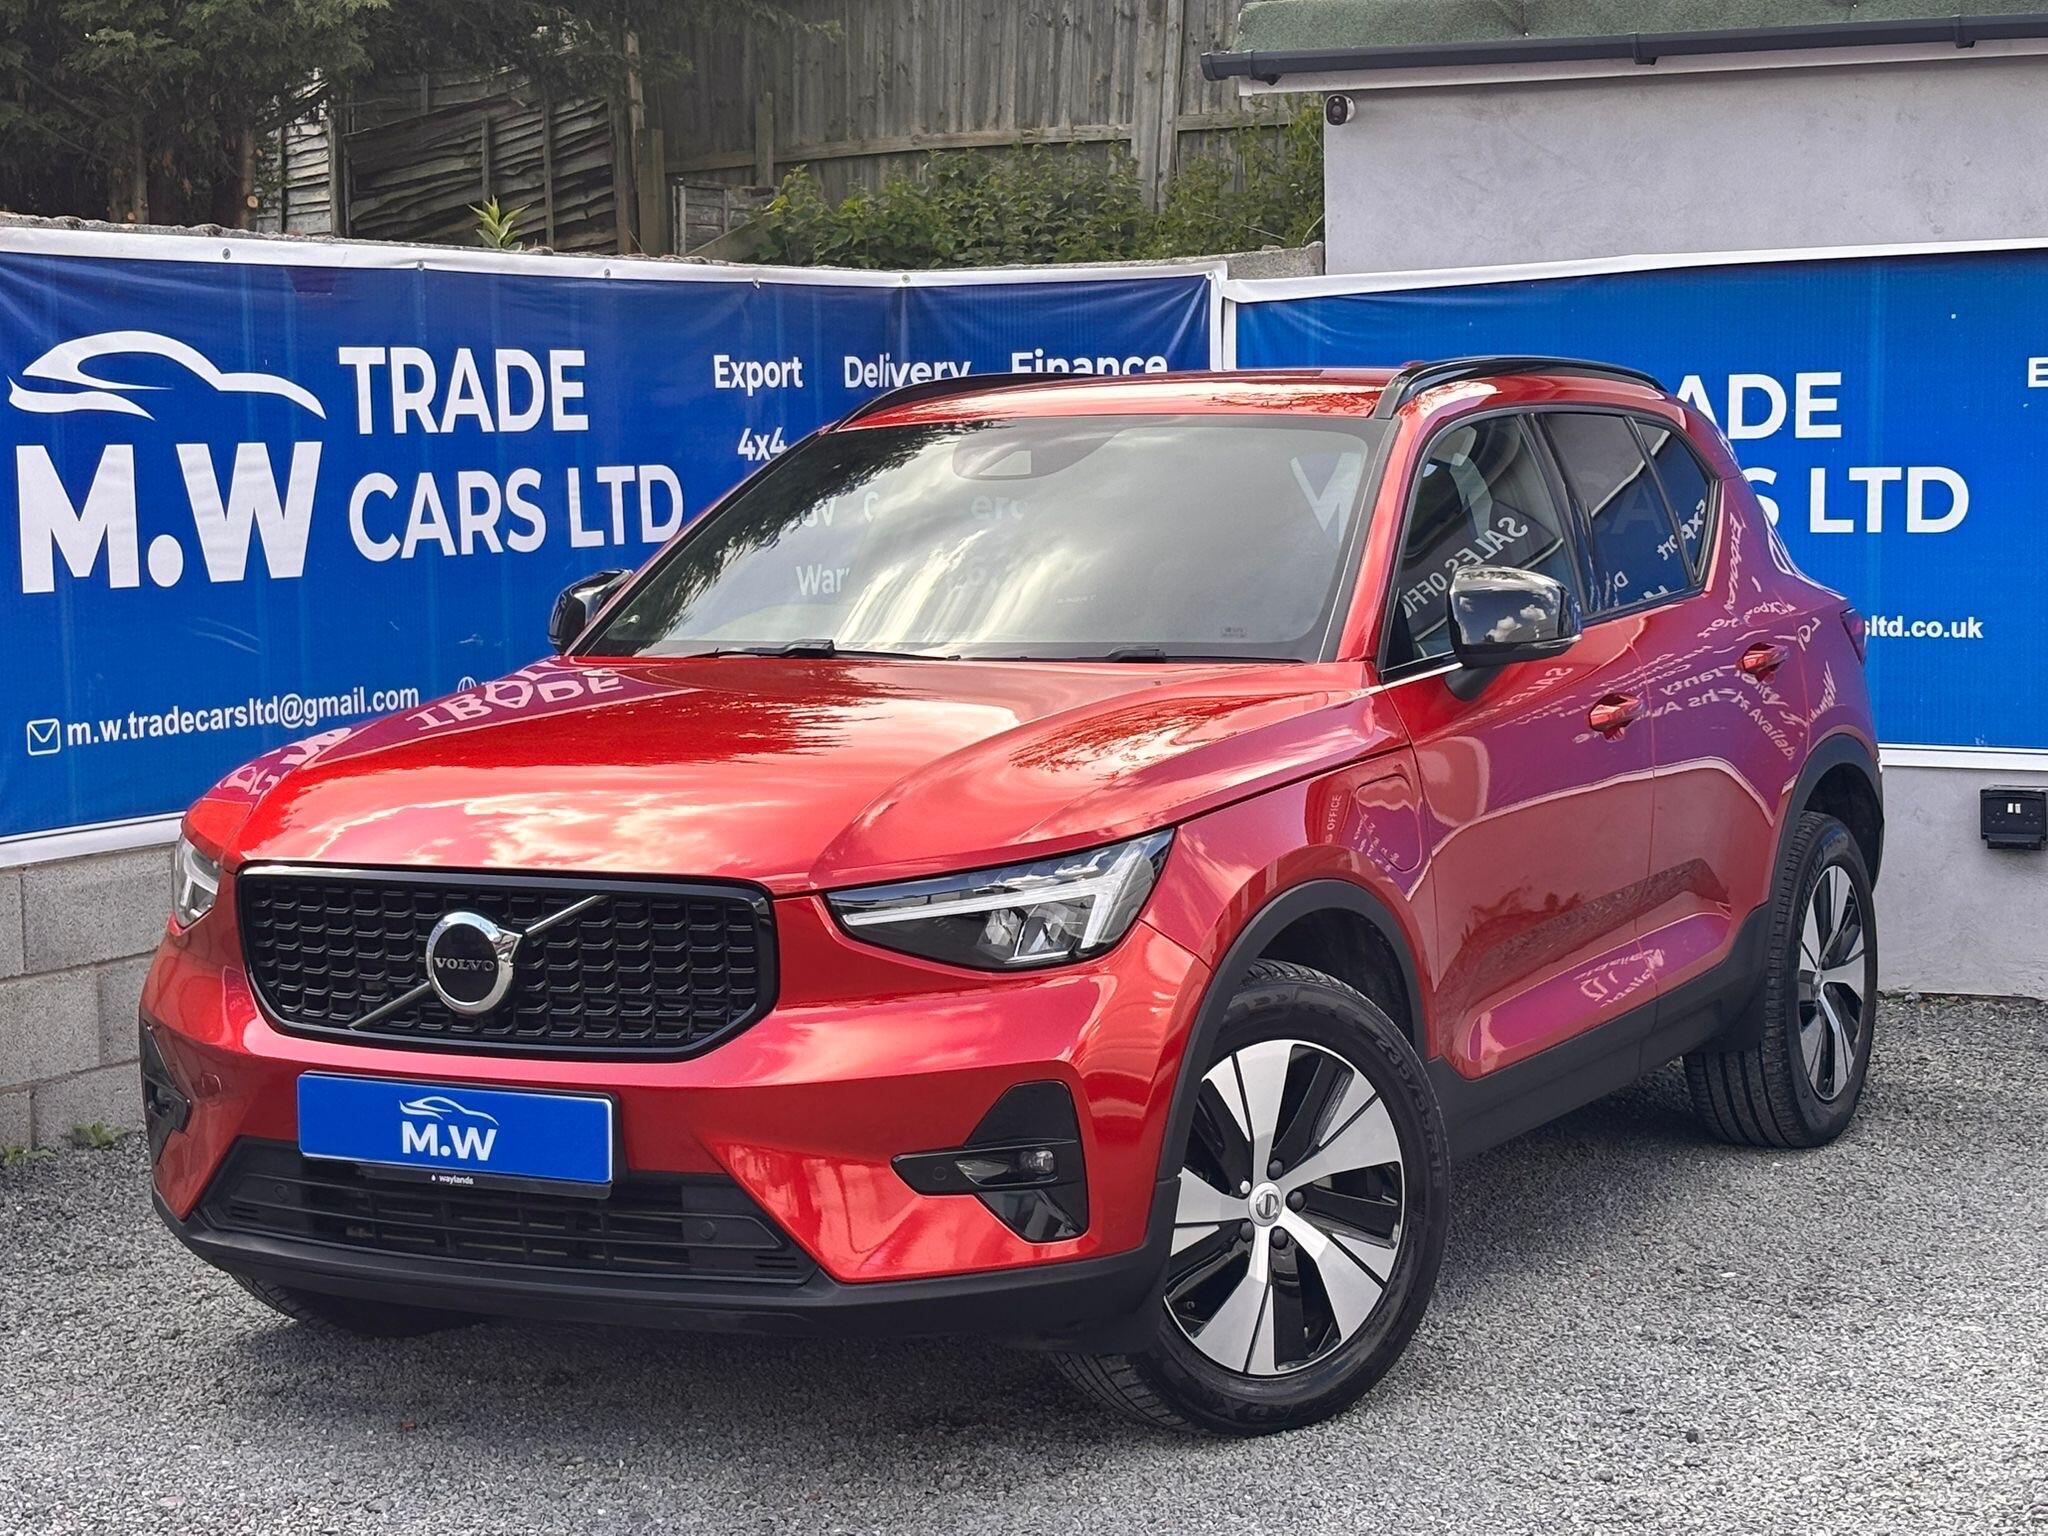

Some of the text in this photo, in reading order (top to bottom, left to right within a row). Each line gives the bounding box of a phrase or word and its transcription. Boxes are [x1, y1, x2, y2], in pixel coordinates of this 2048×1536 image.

[338, 346, 589, 434] TRADE
[713, 348, 1168, 396] Export Delivery Finance
[737, 427, 787, 461] 4x4
[16, 441, 322, 593] M.W
[349, 464, 683, 562] CARS LTD
[1809, 466, 1969, 534] LTD
[67, 685, 419, 747] m.w.tradecarsltd@gmail.com
[434, 957, 495, 972] VOLVO
[401, 1121, 497, 1162] M.W
[439, 1175, 474, 1185] waylands
